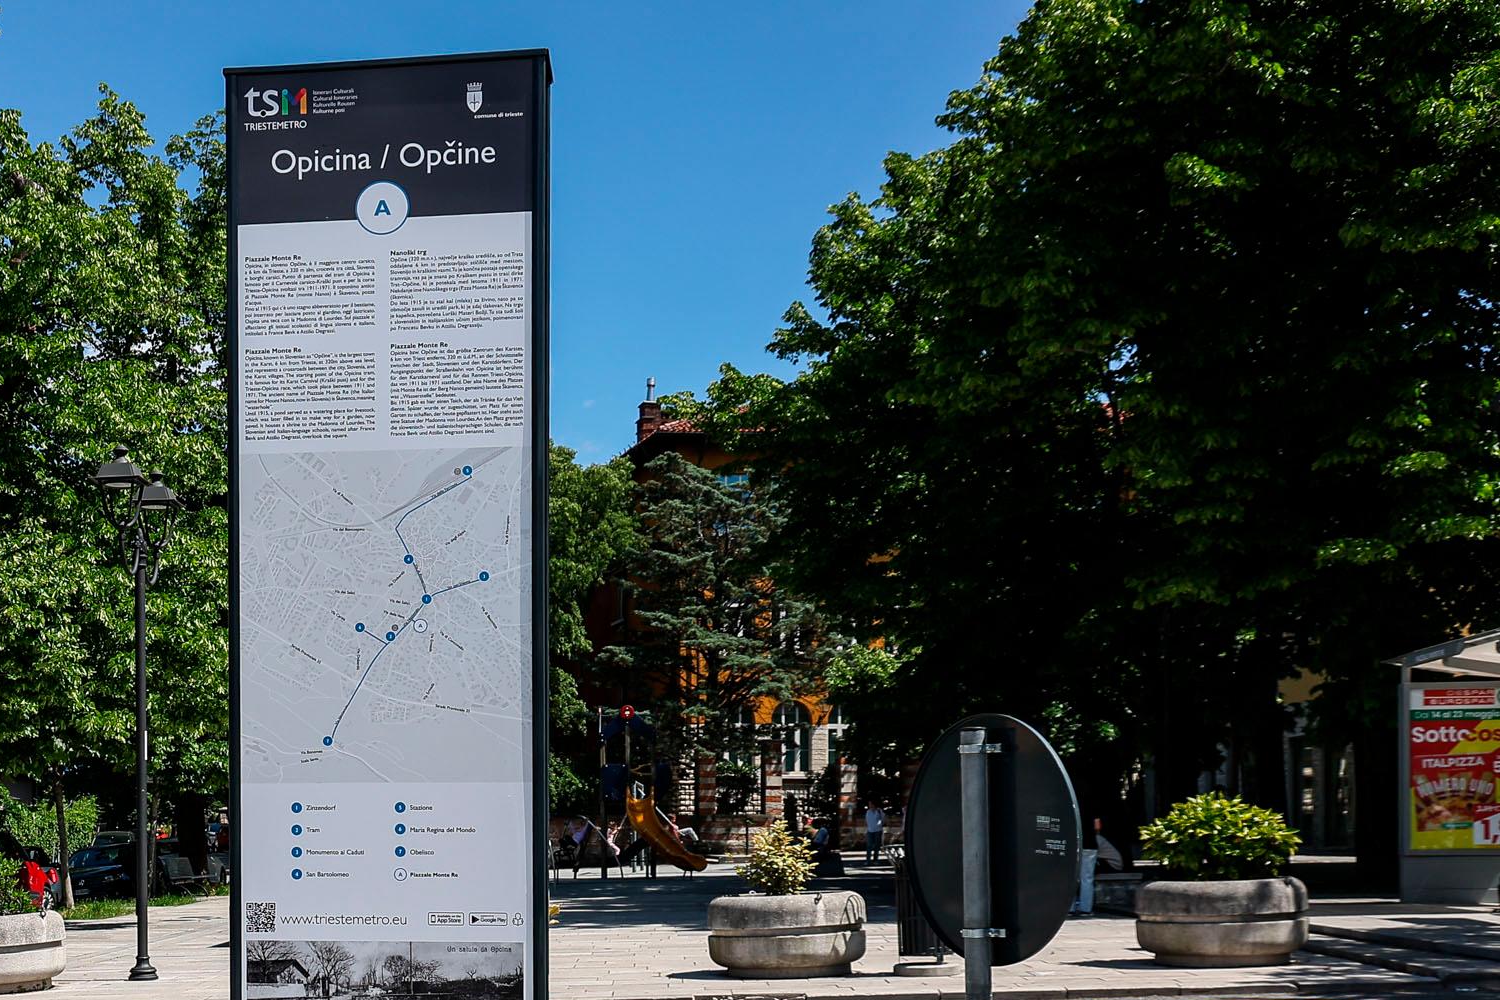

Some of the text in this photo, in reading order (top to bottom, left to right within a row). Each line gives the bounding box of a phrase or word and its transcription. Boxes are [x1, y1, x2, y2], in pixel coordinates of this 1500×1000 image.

[244, 120, 307, 131] TRIESTEMETRO
[271, 140, 497, 180] Opicina / Opčine
[373, 200, 391, 216] A
[1421, 756, 1485, 768] ITALPIZZA
[426, 826, 445, 834] Regina
[280, 912, 408, 926] www.triestemetro.eu
